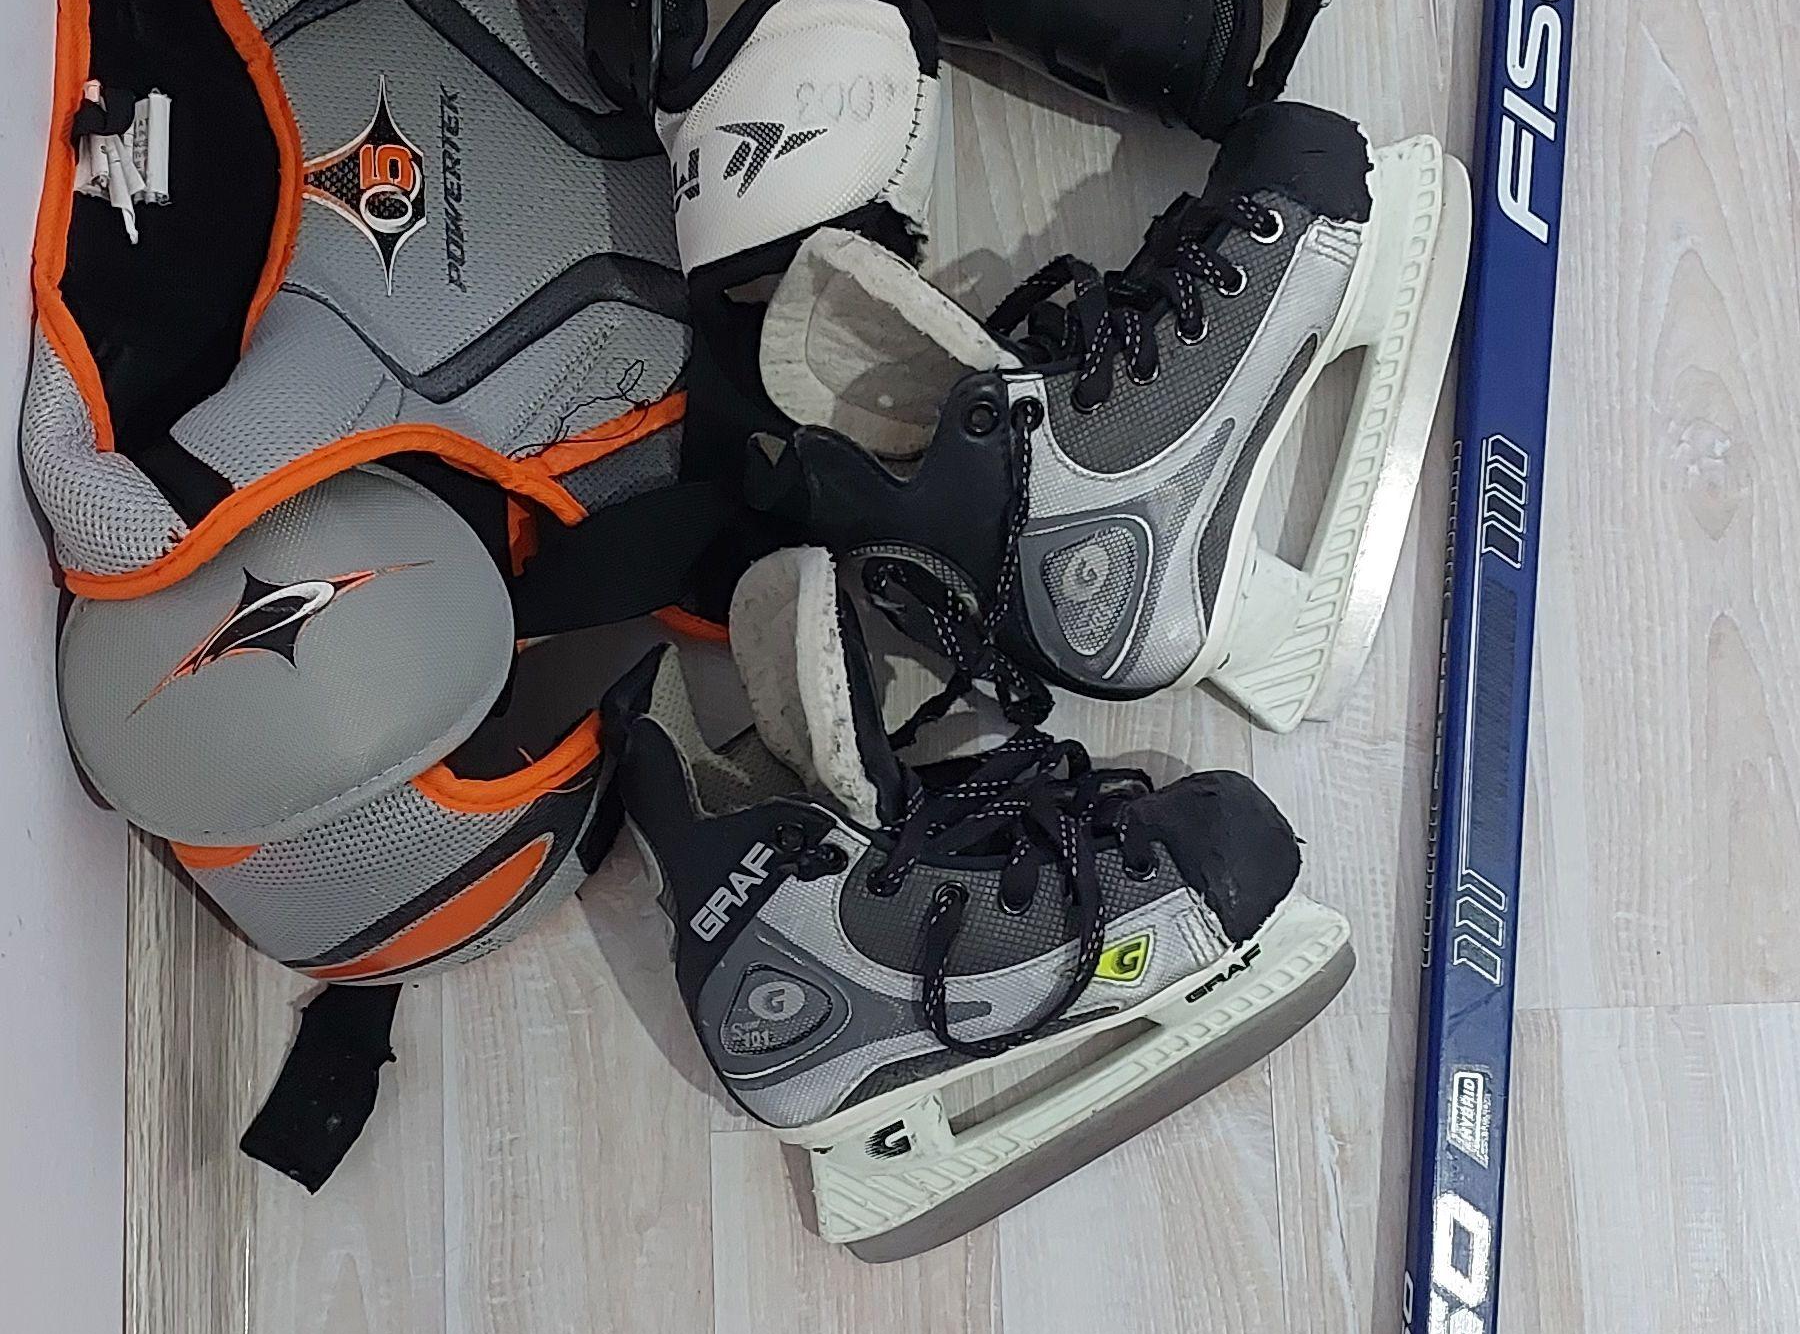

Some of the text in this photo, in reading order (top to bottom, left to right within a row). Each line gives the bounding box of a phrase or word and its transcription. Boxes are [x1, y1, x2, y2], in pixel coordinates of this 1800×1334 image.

[438, 78, 468, 294] POWERTEK
[690, 842, 775, 942] GRAF
[1111, 941, 1143, 975] G
[1184, 943, 1262, 1004] GRAF
[765, 988, 785, 1014] G
[864, 1119, 912, 1161] G
